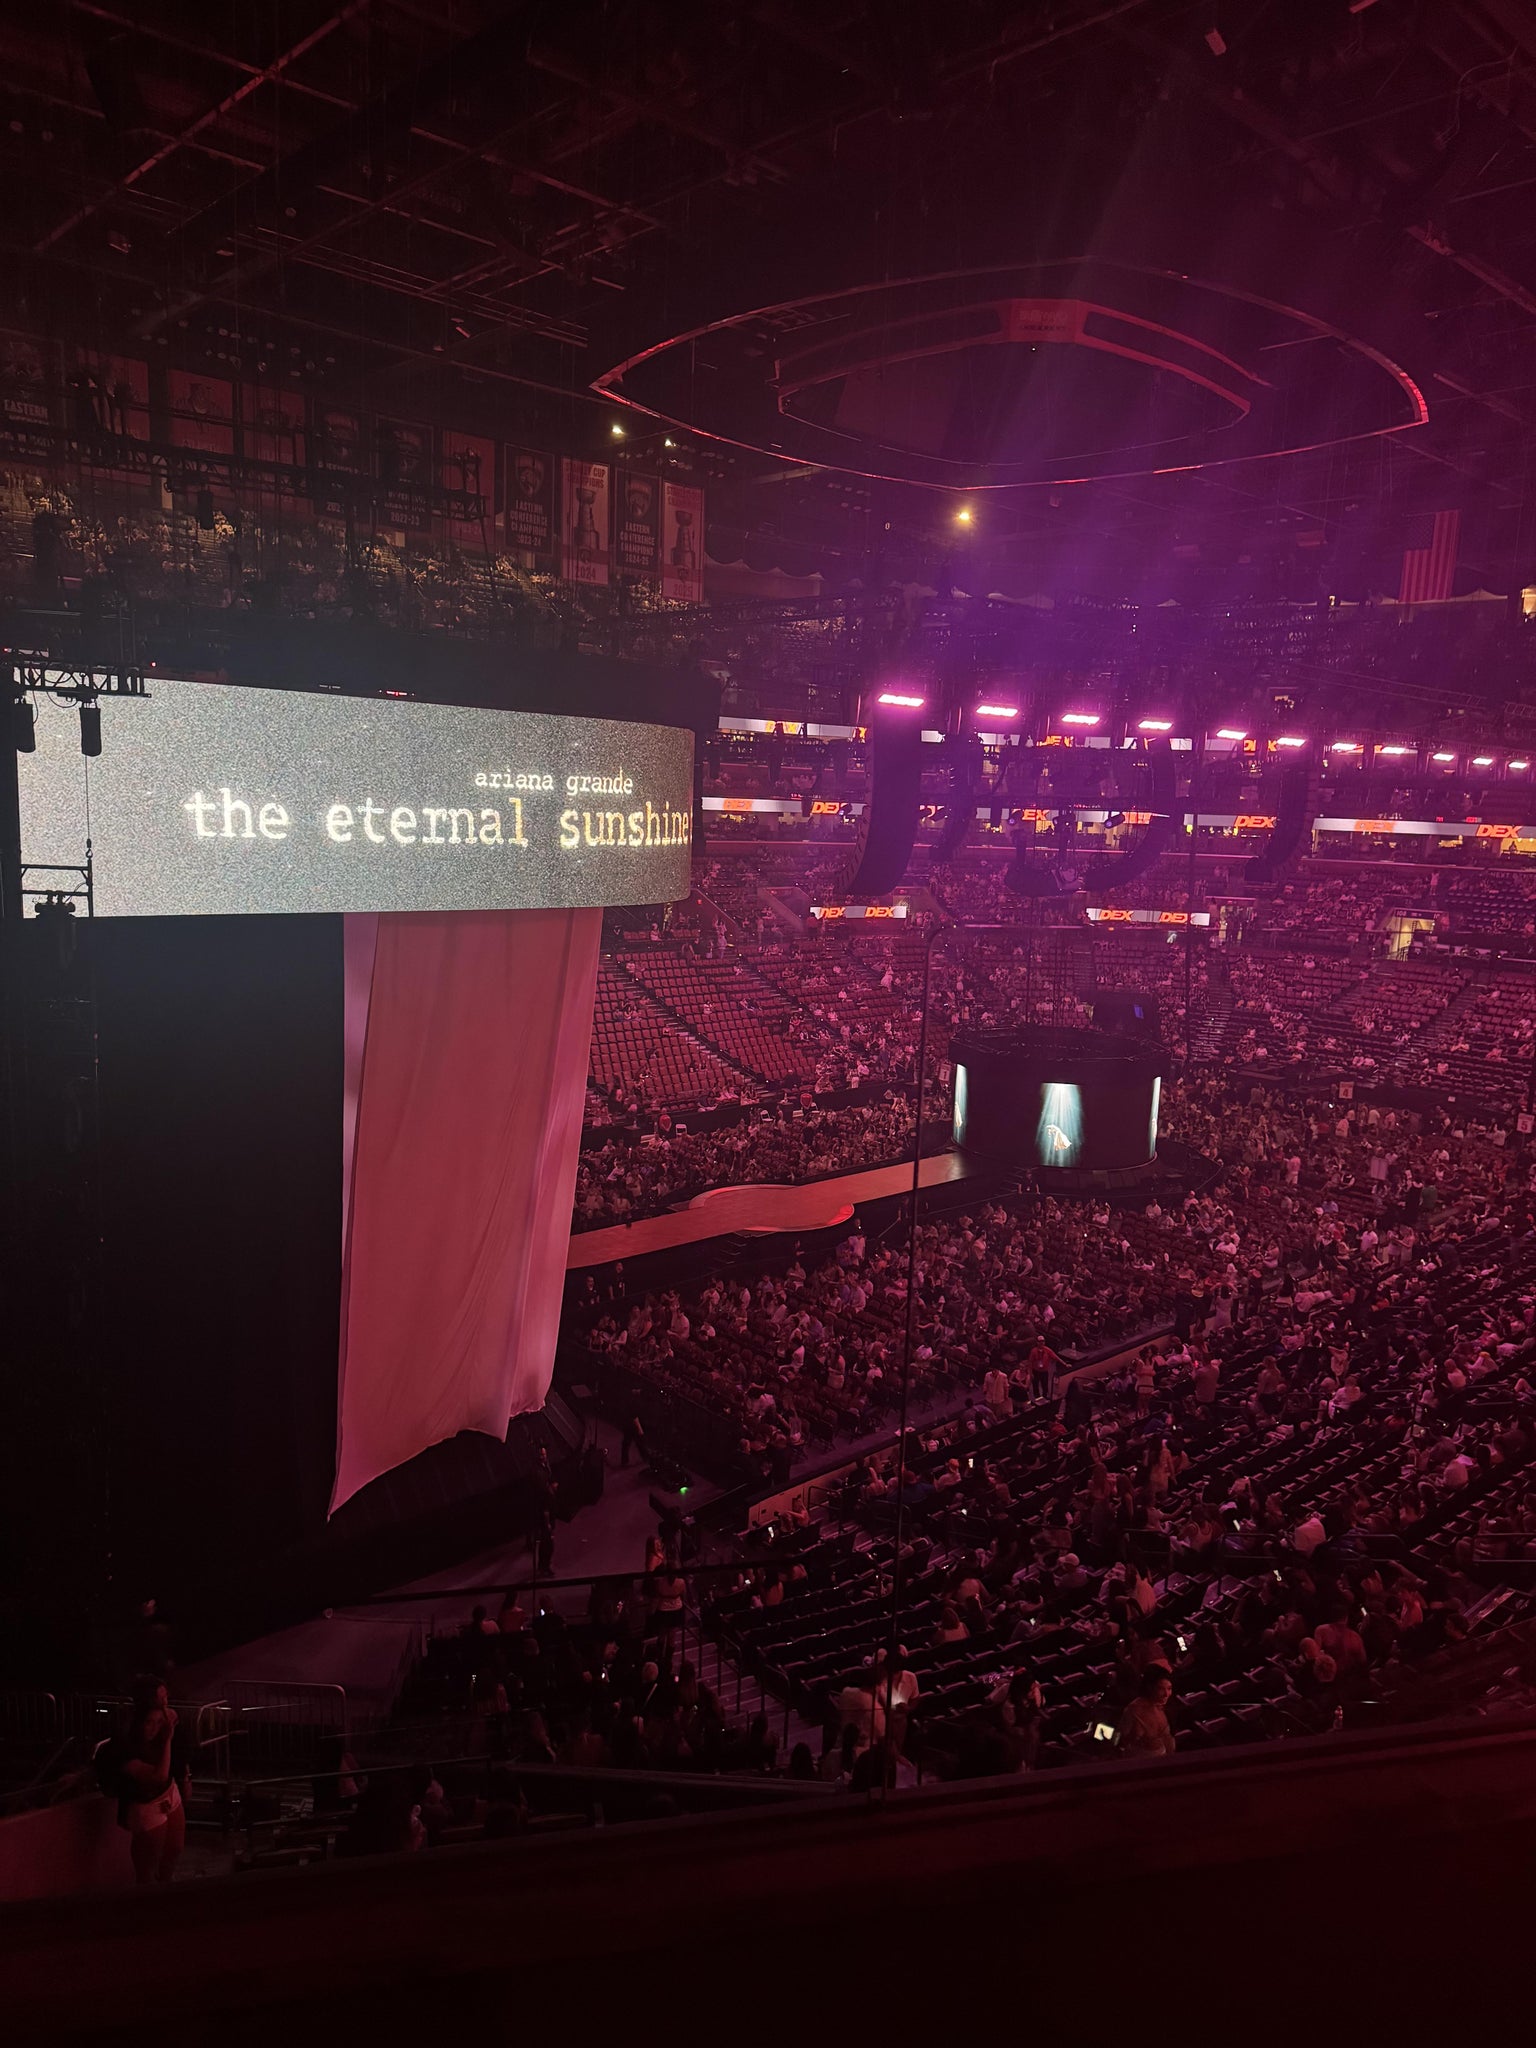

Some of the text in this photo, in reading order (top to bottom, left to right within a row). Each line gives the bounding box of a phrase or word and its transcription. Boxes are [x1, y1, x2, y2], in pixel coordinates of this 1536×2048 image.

[475, 767, 633, 796] ariana grande
[811, 801, 848, 814] DE
[184, 787, 689, 848] the eternal sunshine
[1234, 815, 1277, 828] DEX
[1475, 824, 1524, 838] DEX
[864, 906, 896, 918] DEX
[1099, 909, 1192, 924] DEX DE
